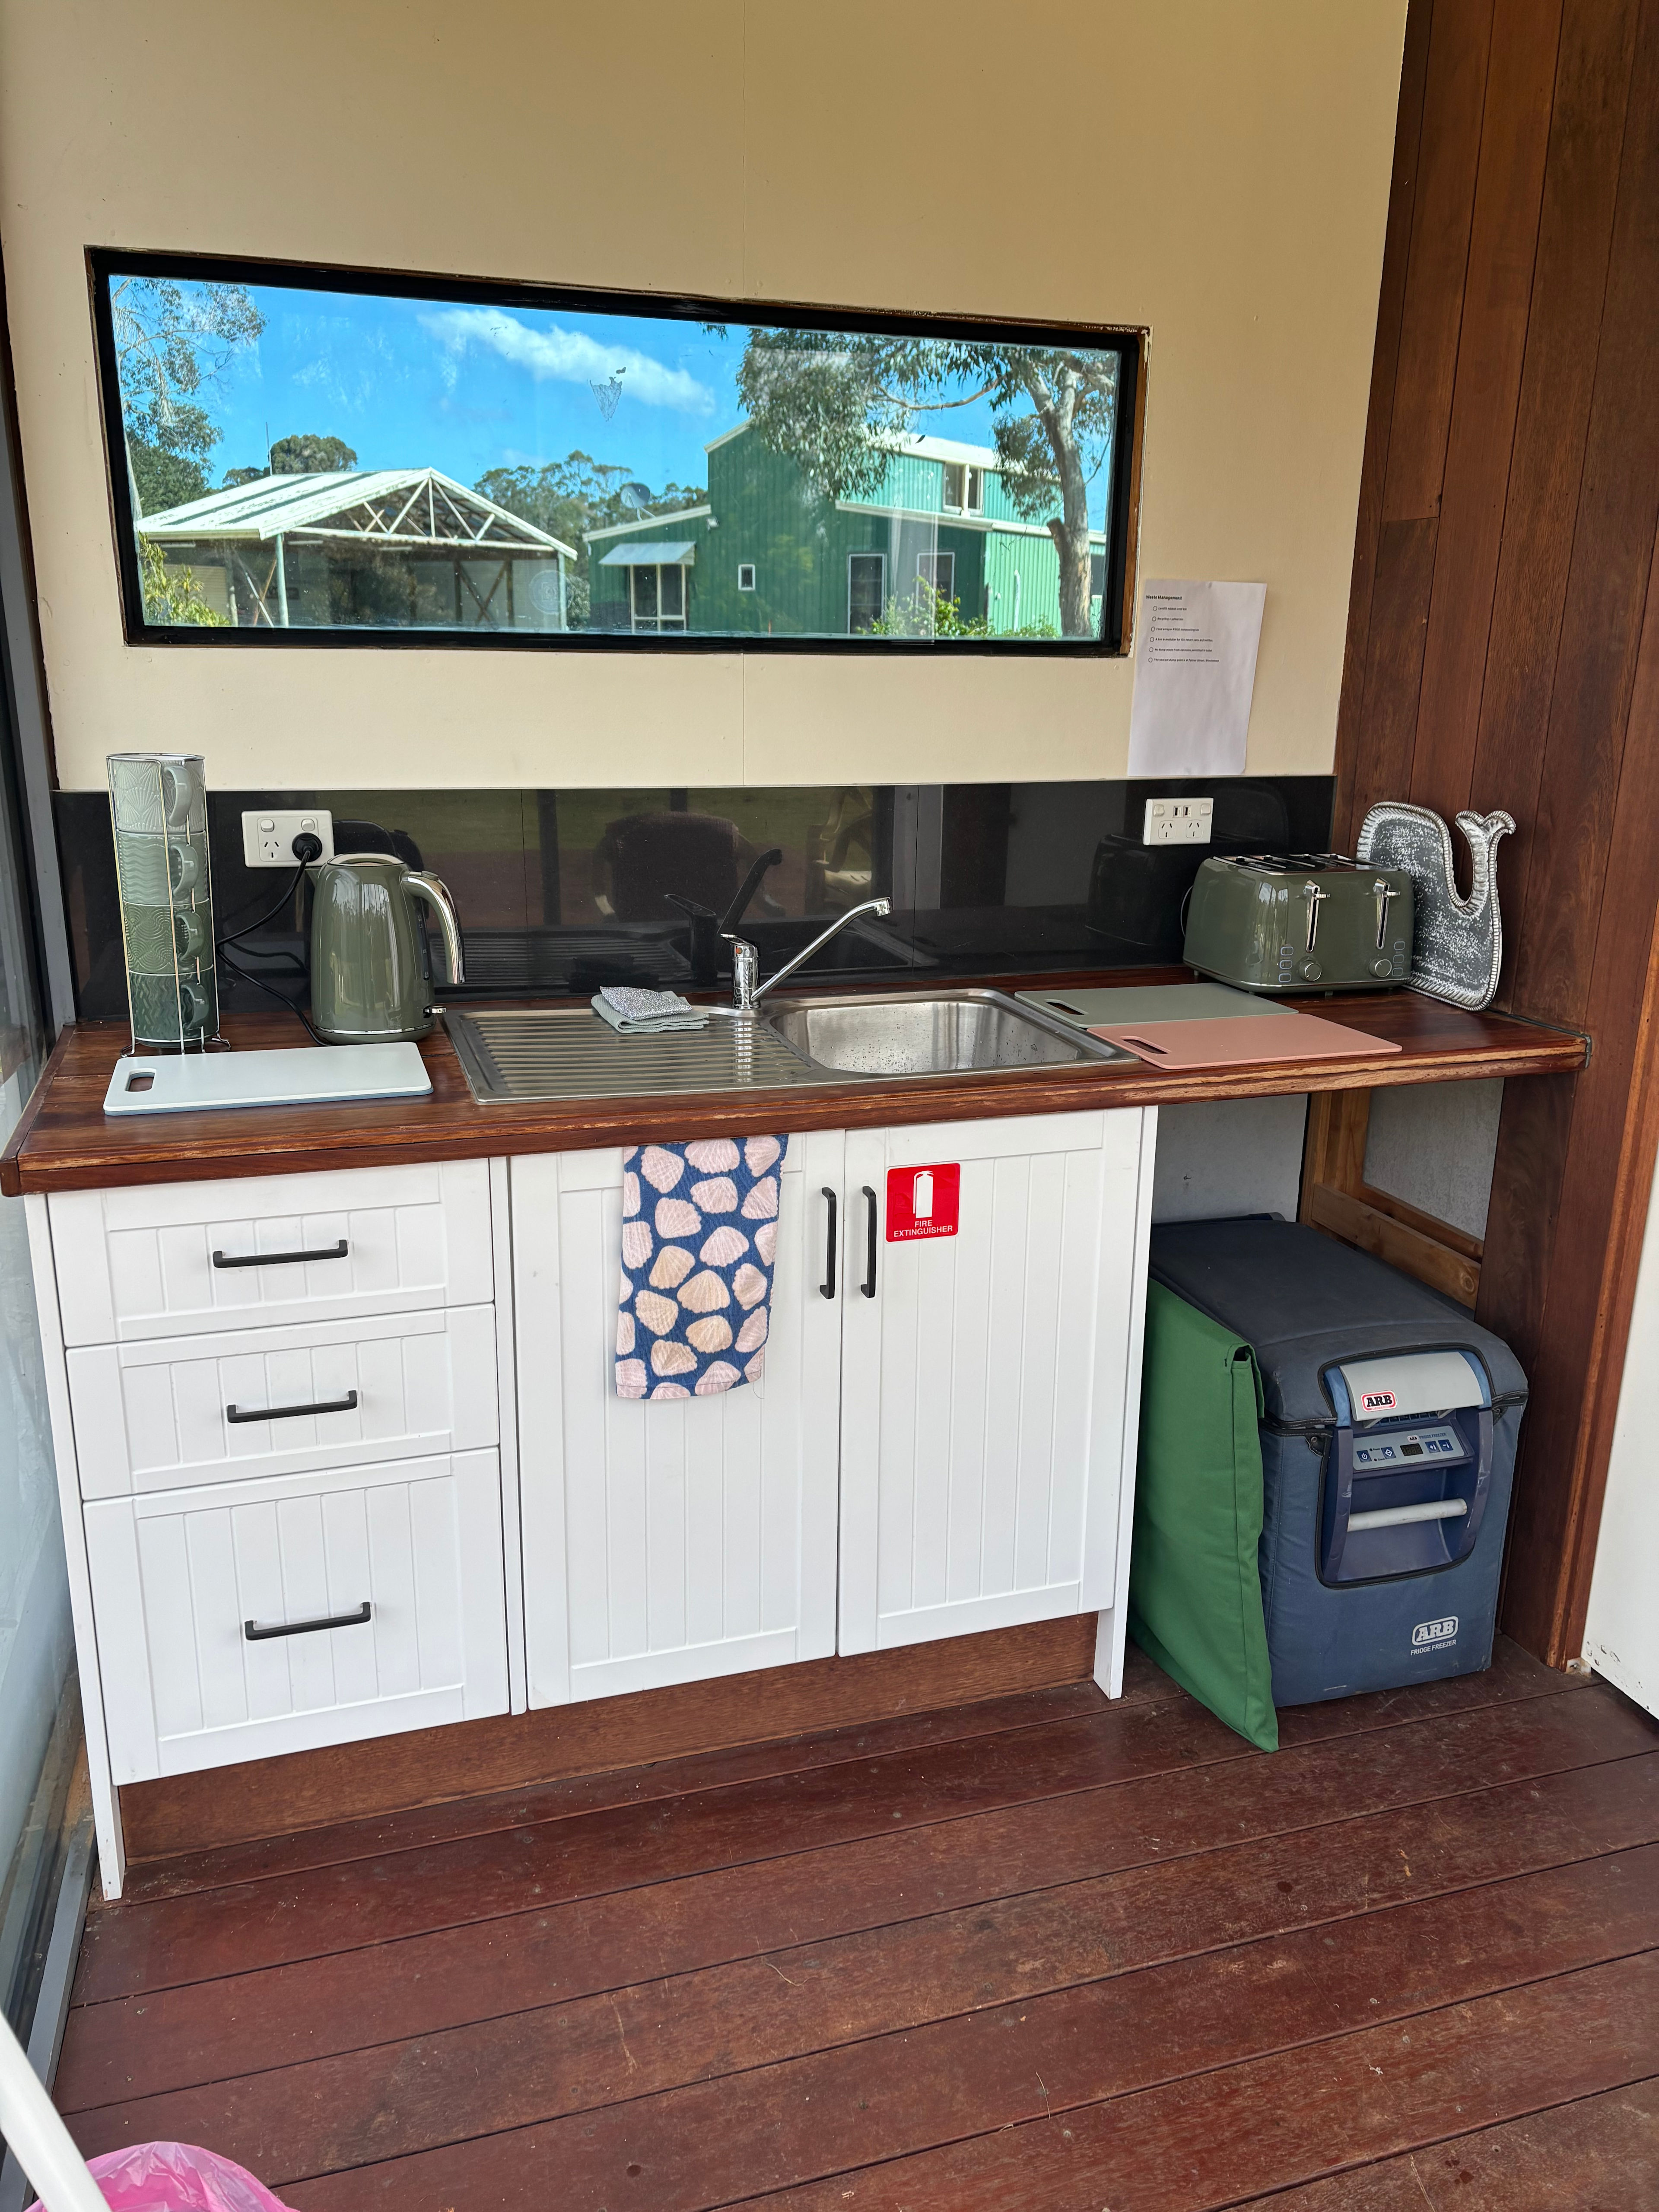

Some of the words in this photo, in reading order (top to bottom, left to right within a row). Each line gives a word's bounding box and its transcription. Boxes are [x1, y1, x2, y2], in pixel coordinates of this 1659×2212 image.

[894, 1225, 953, 1237] EXTINGUISHER
[1367, 1395, 1392, 1407] ARB
[1416, 1621, 1454, 1642] ARB
[1410, 1646, 1431, 1656] FRIDGE
[1431, 1640, 1456, 1651] FREEZER
